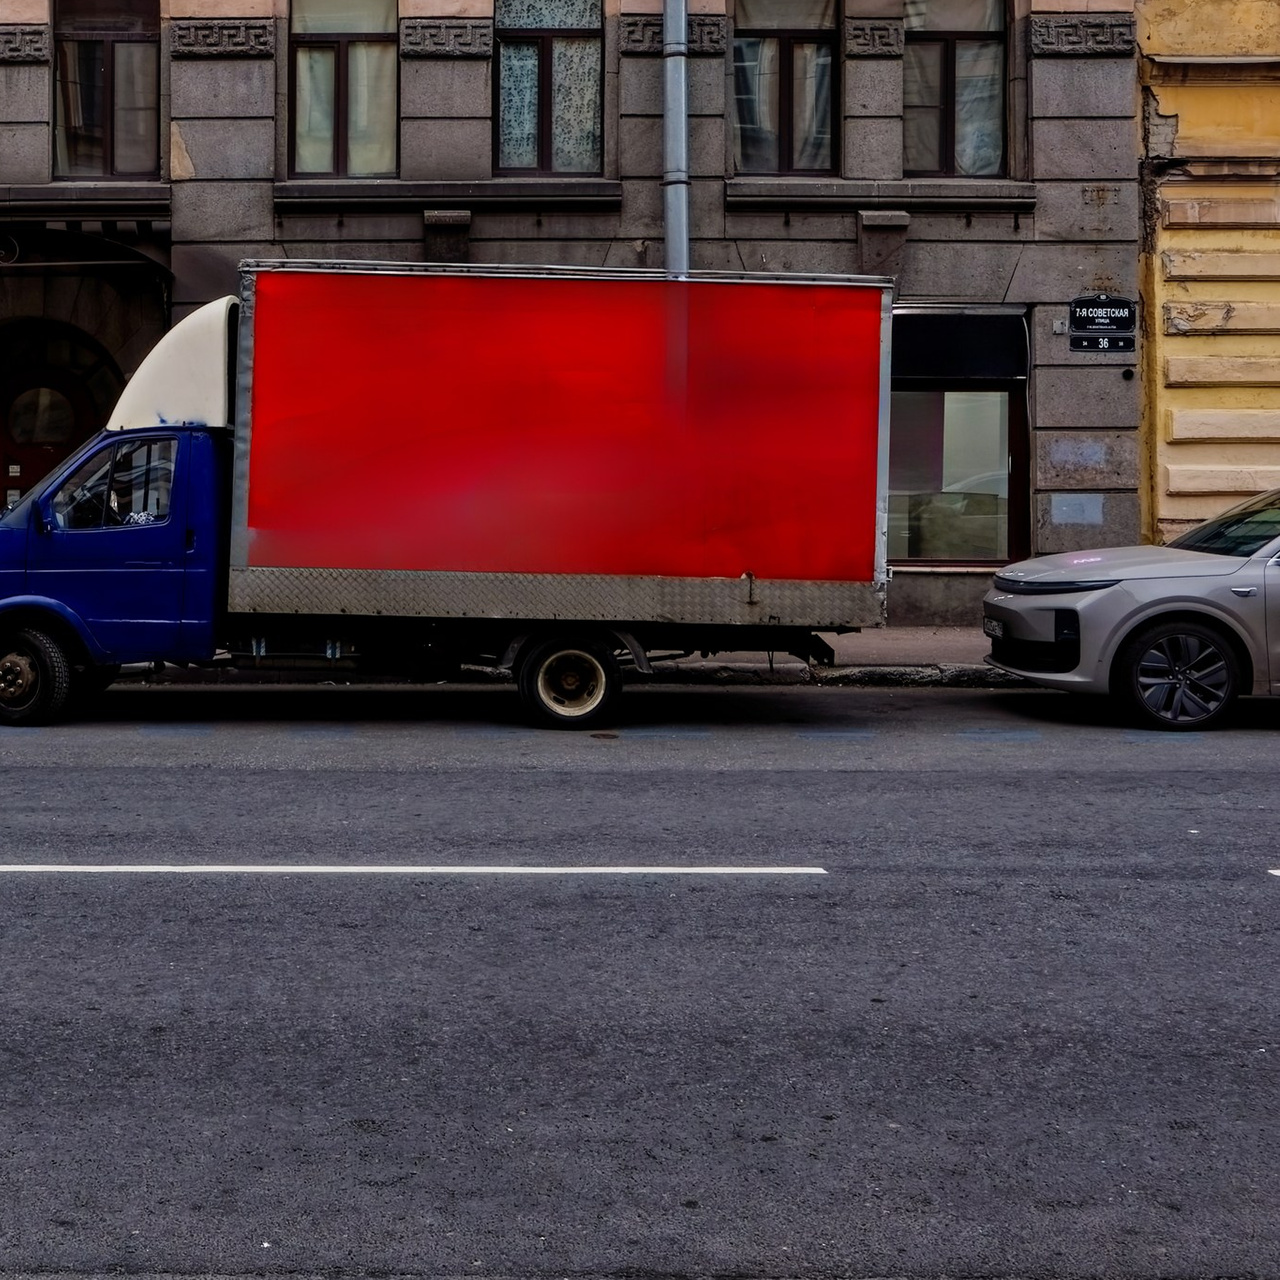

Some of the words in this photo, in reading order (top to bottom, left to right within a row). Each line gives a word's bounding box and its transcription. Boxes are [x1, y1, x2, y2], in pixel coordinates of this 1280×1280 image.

[1075, 308, 1087, 317] 7-Я
[1087, 308, 1129, 317] СОВЕТСКАЯ
[1098, 338, 1109, 348] 36
